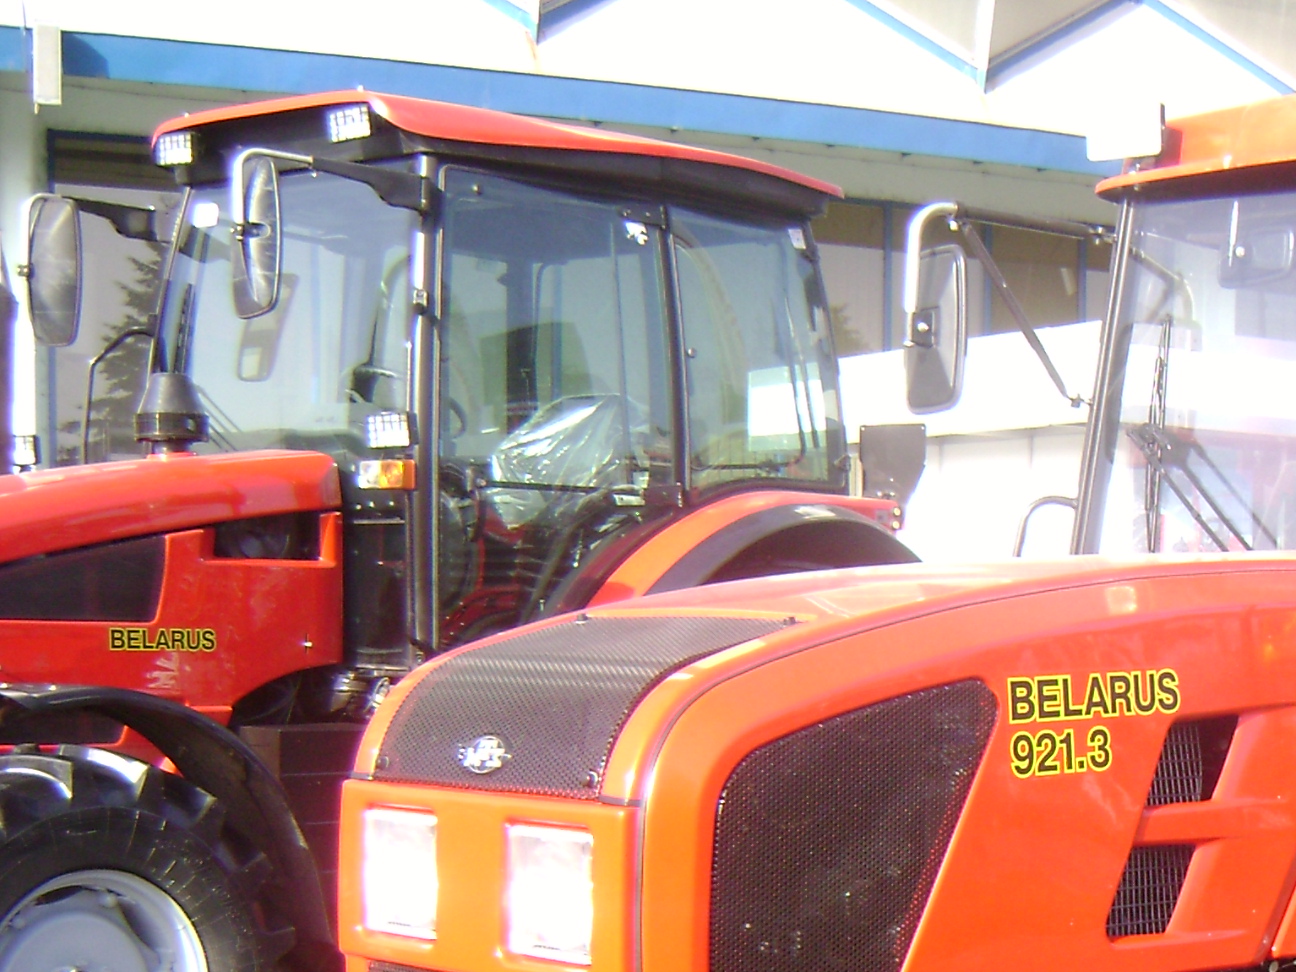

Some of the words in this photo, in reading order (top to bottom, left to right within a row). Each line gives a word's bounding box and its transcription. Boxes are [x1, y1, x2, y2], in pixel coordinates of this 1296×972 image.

[109, 627, 216, 652] BELARUS
[1007, 668, 1180, 724] BELARUS
[1010, 725, 1112, 778] 921.3
